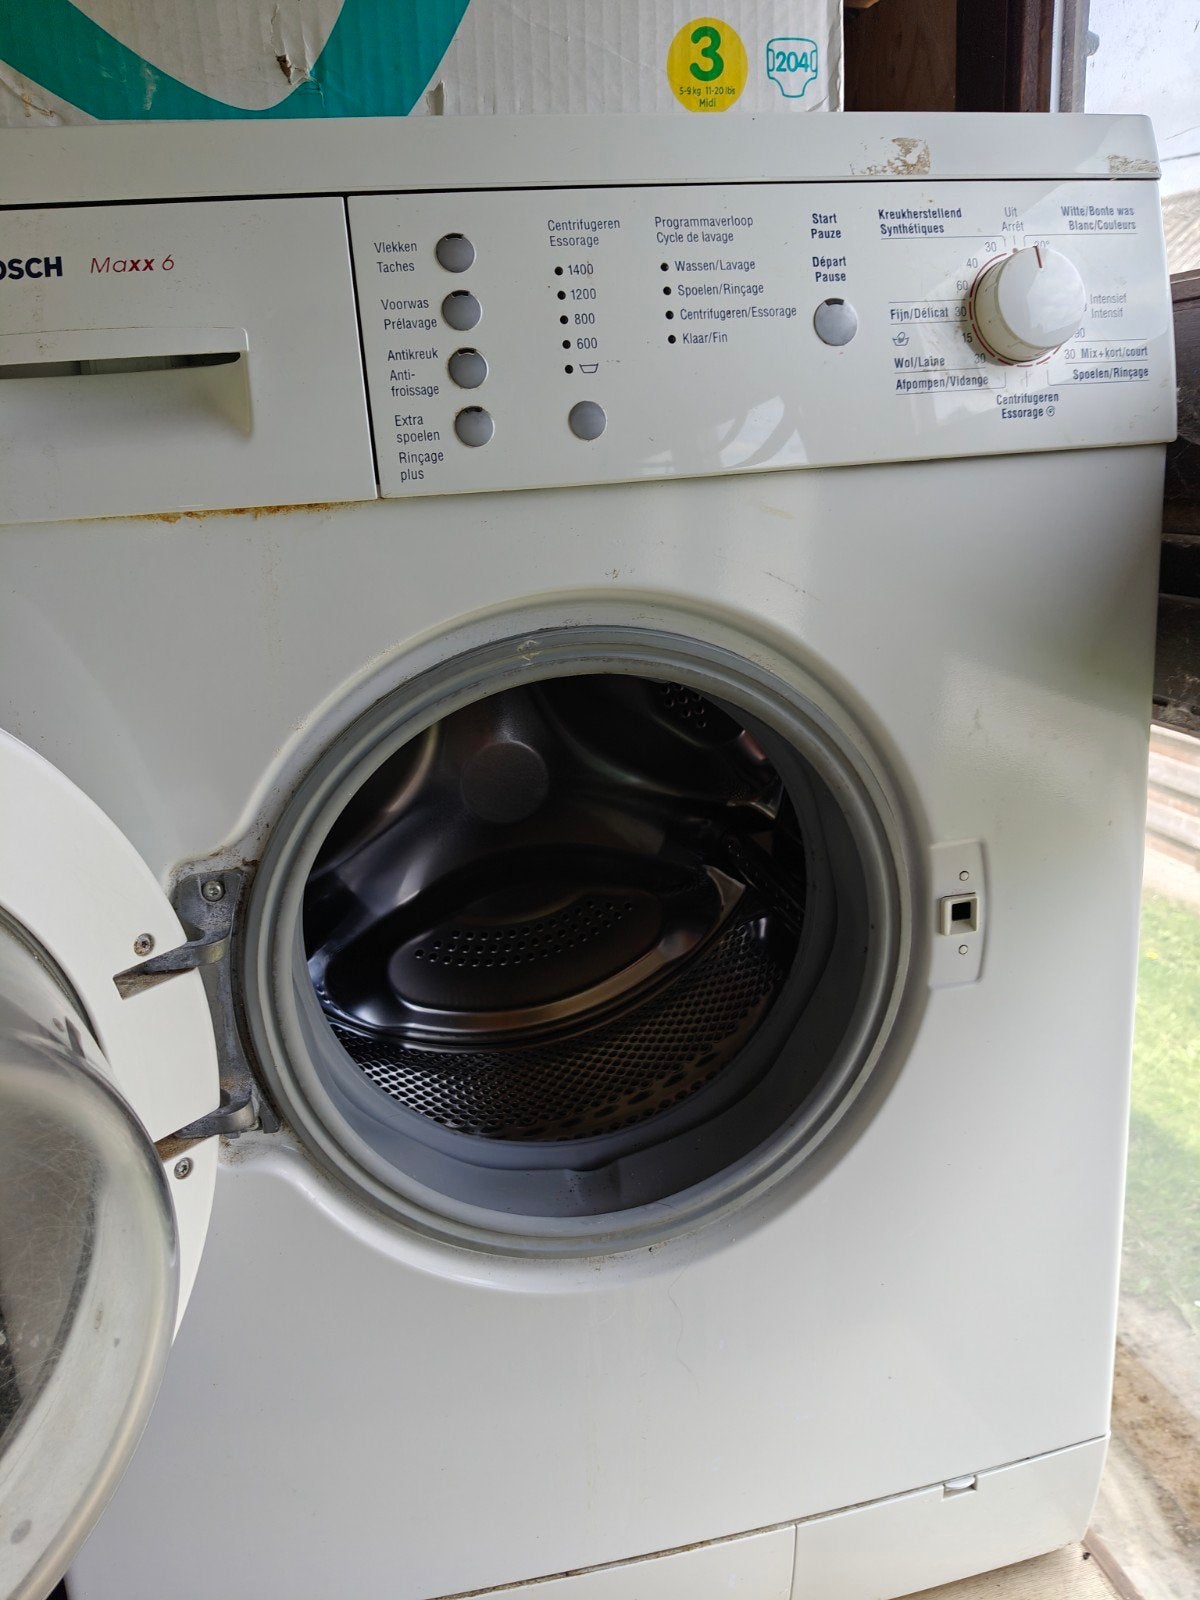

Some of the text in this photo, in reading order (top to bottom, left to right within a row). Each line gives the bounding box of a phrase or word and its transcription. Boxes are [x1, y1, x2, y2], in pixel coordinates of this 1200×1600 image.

[689, 26, 724, 81] 3
[776, 51, 809, 72] 204
[692, 87, 701, 95] kg
[699, 99, 716, 107] Midi
[878, 208, 962, 220] Kreukherstellend
[1004, 207, 1017, 217] Uit
[1061, 206, 1134, 217] Witte/Bonte was
[655, 216, 753, 229] Programmaverloop
[812, 213, 837, 224] Start
[548, 219, 620, 231] Centrifugeren
[880, 223, 944, 235] Synthétiques
[1002, 221, 1024, 232] Arrêt
[1068, 219, 1136, 232] Blanc/Couleurs
[657, 231, 733, 245] Cycle de lavage
[811, 228, 841, 239] Pauze
[550, 235, 599, 247] Essorage
[985, 242, 997, 252] 30
[374, 242, 417, 253] Vlekken
[91, 255, 174, 273] Maxx 6
[377, 262, 415, 273] Taches
[675, 260, 755, 272] Wassen/Lavage
[813, 256, 846, 268] Départ
[967, 258, 978, 268] 40
[568, 264, 594, 275] 1400
[815, 272, 846, 282] Pause
[678, 283, 764, 297] Spoelen/Rinçage
[957, 280, 968, 290] 60
[571, 289, 596, 300] 1200
[381, 299, 429, 310] Voorwas
[574, 313, 595, 324] 800
[680, 307, 797, 321] Centrifugeren/Essorage
[890, 306, 967, 321] Fijn/Délicat 30
[1091, 308, 1123, 318] Intensif
[384, 317, 437, 330] Prélavage
[577, 338, 598, 349] 600
[683, 332, 727, 344] Klaar/Fin
[962, 333, 973, 343] 15
[387, 348, 438, 360] Antikreuk
[1065, 349, 1075, 359] 30
[894, 353, 986, 369] Wol/Laine 30
[390, 370, 415, 382] Anti-
[1073, 367, 1148, 381] Spoelen/Rinçage
[896, 376, 988, 392] Afpompen/Vidange
[391, 384, 439, 398] froissage
[996, 393, 1059, 405] Centrifugeren
[1002, 407, 1043, 418] Essorage
[395, 415, 423, 426] Extra
[396, 431, 440, 443] spoelen
[399, 451, 444, 464] Rinçage
[400, 469, 424, 483] plus
